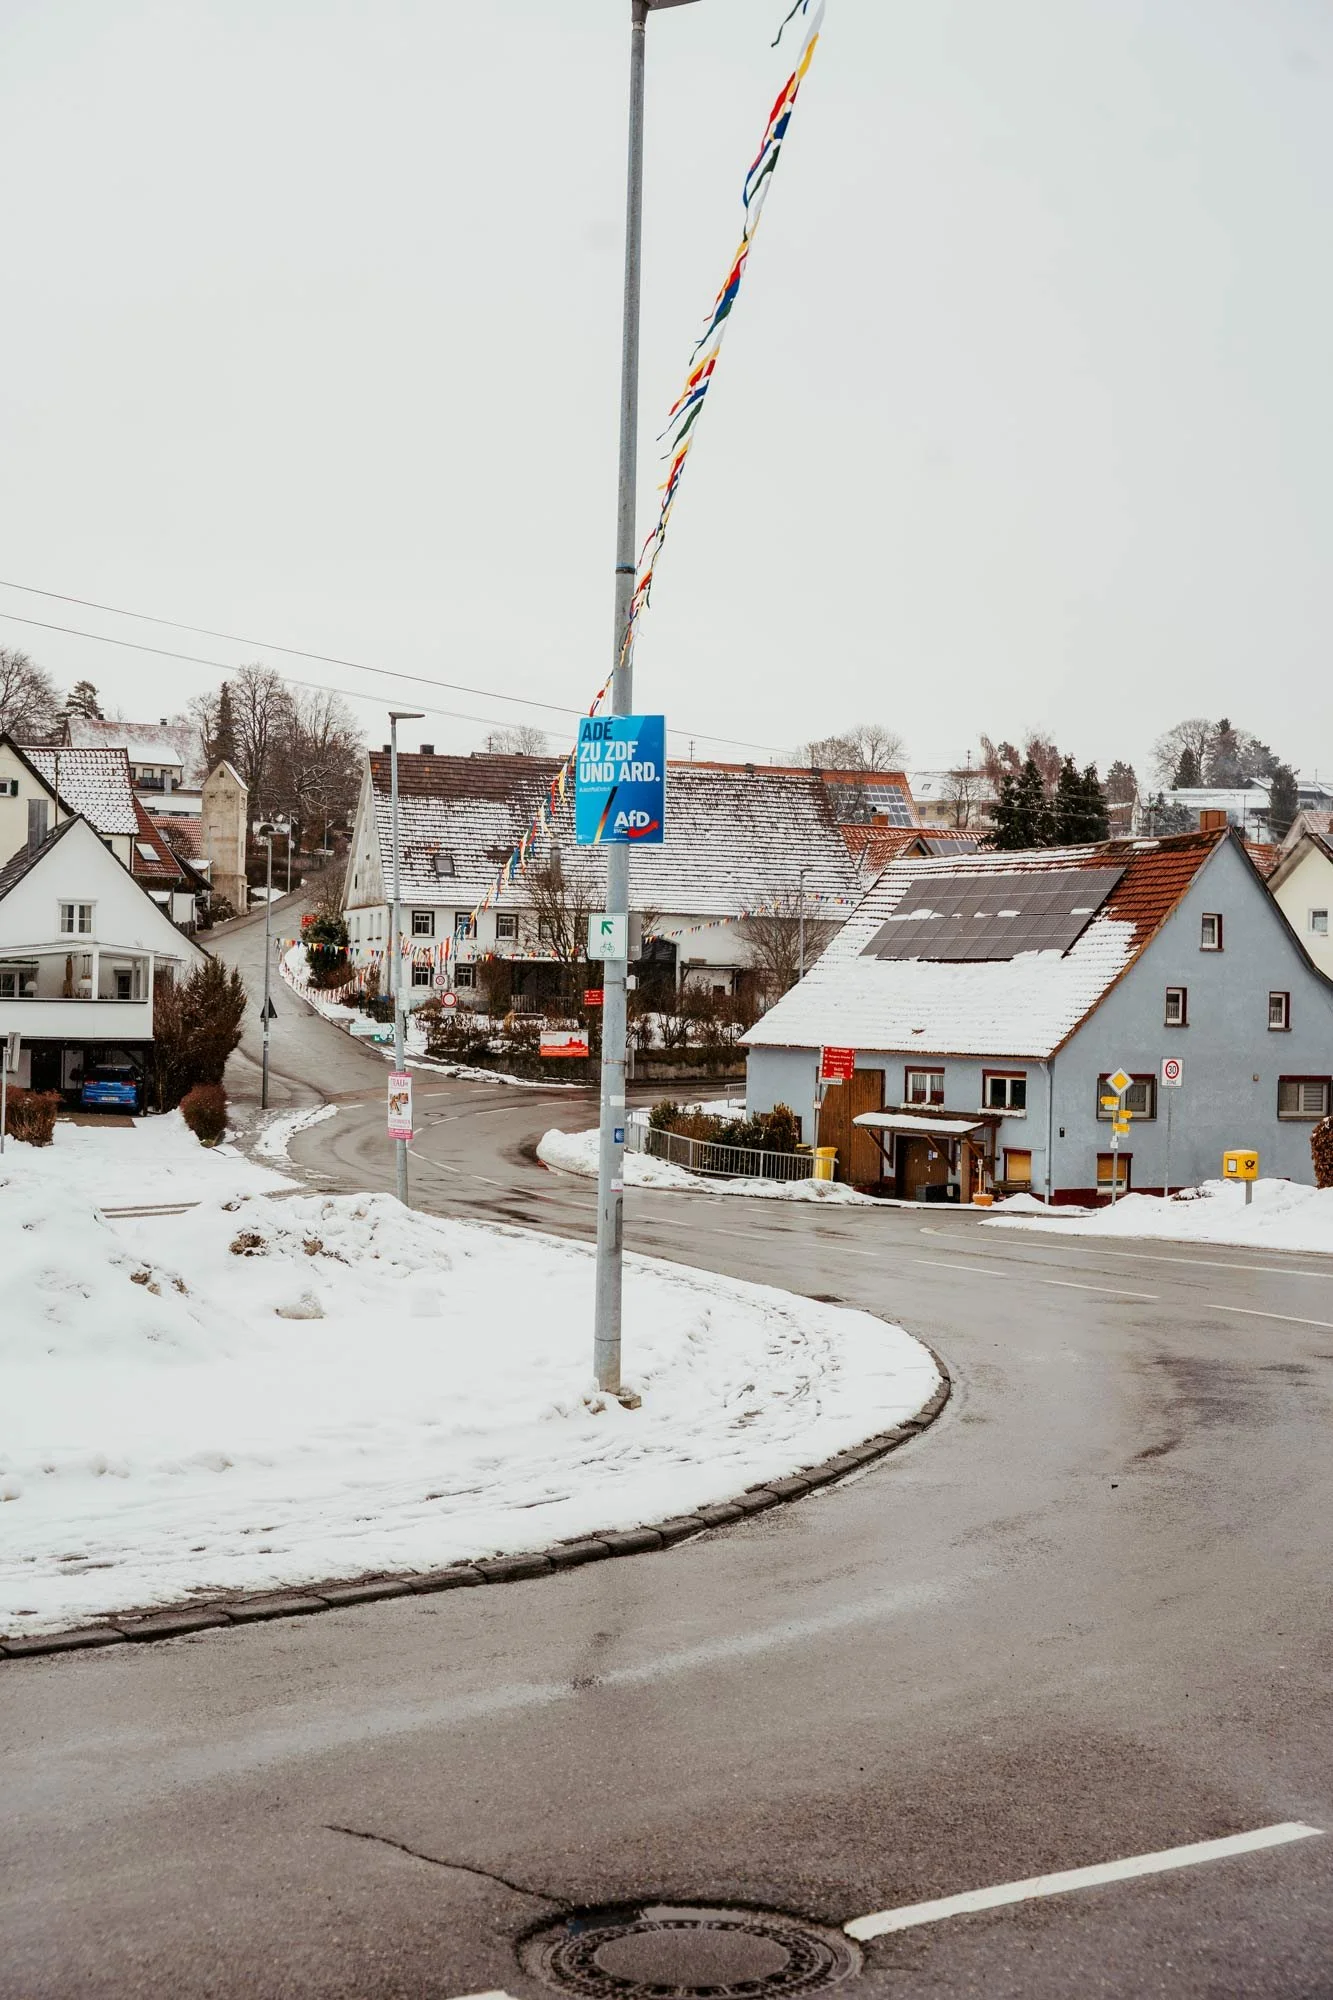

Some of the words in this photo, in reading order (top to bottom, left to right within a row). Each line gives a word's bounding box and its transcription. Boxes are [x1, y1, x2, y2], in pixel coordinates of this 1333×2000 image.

[580, 741, 600, 762] ZU
[605, 741, 638, 761] ZDF
[580, 762, 615, 783] UND
[619, 762, 660, 782] ARD.
[614, 810, 650, 827] AfD
[1168, 1065, 1176, 1074] 30
